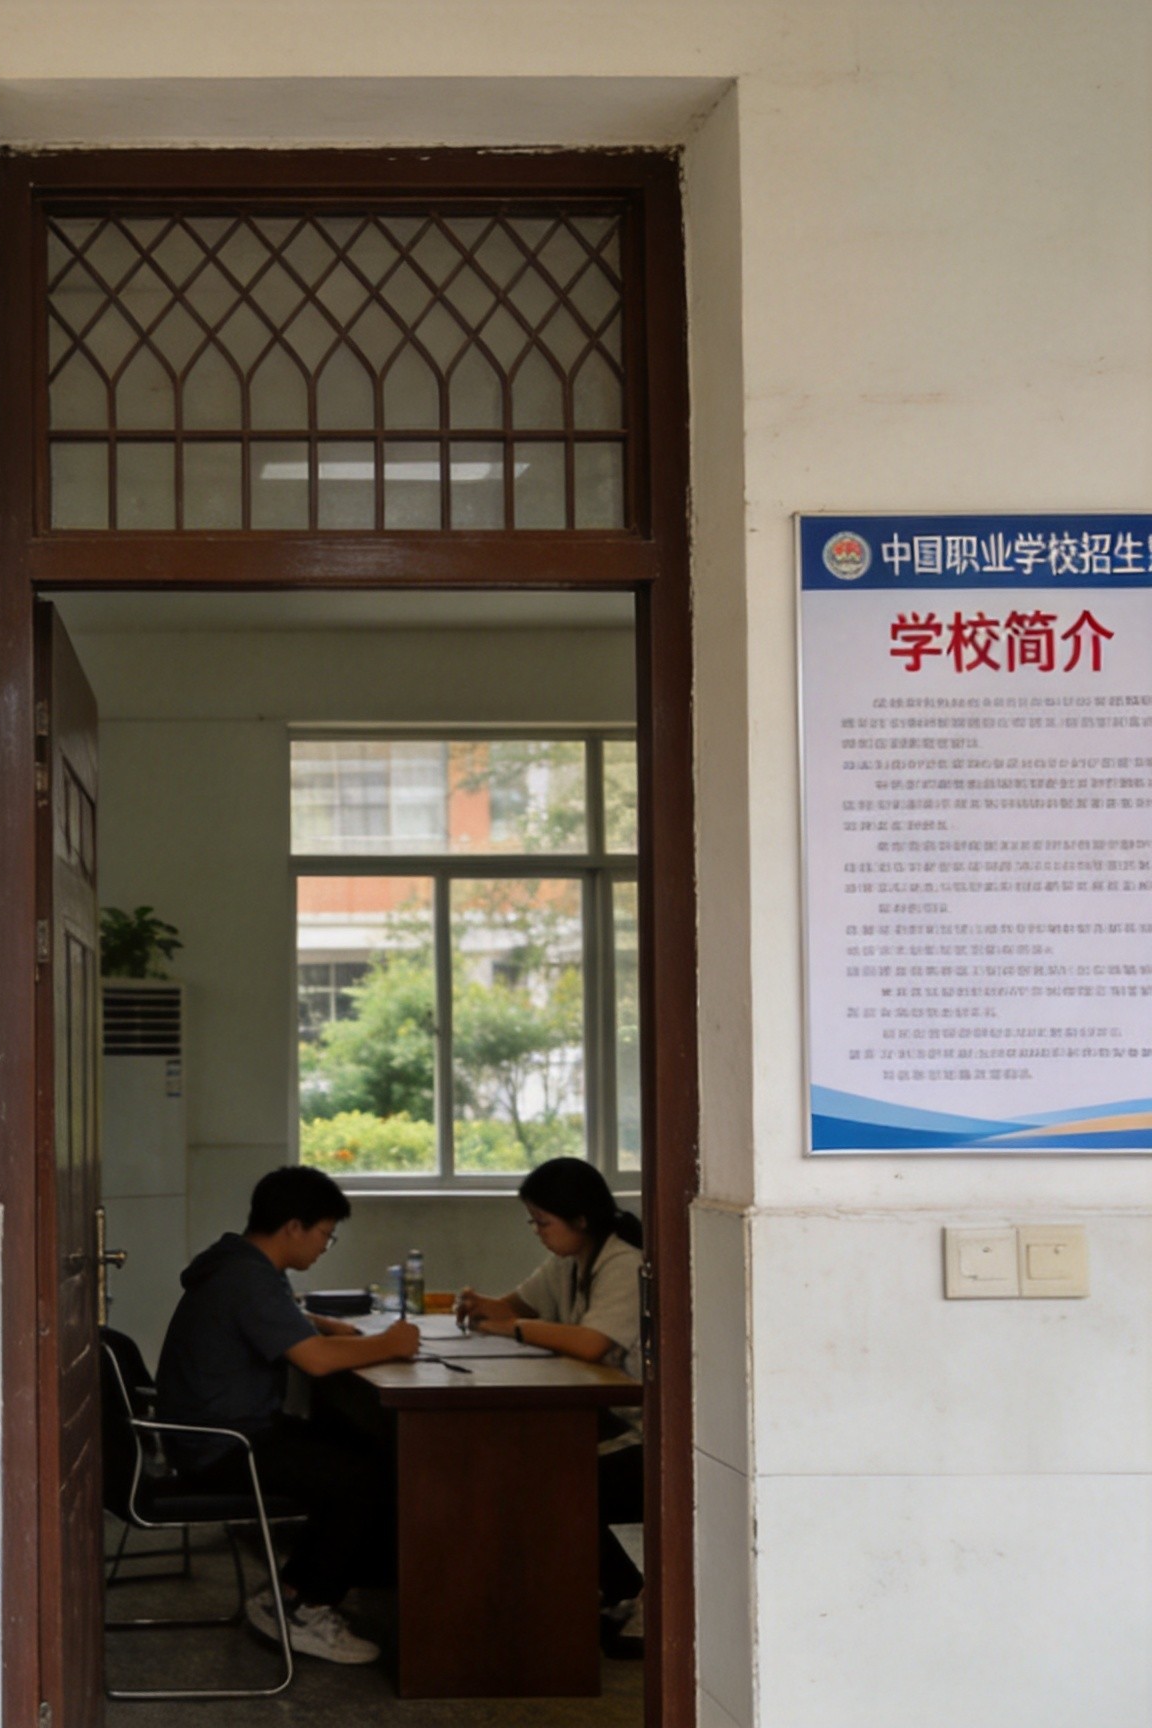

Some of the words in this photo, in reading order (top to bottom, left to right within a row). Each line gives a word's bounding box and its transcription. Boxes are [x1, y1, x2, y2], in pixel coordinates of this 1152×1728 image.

[881, 532, 1152, 576] 中国职业学校招生
[890, 610, 1114, 673] 学校简介
